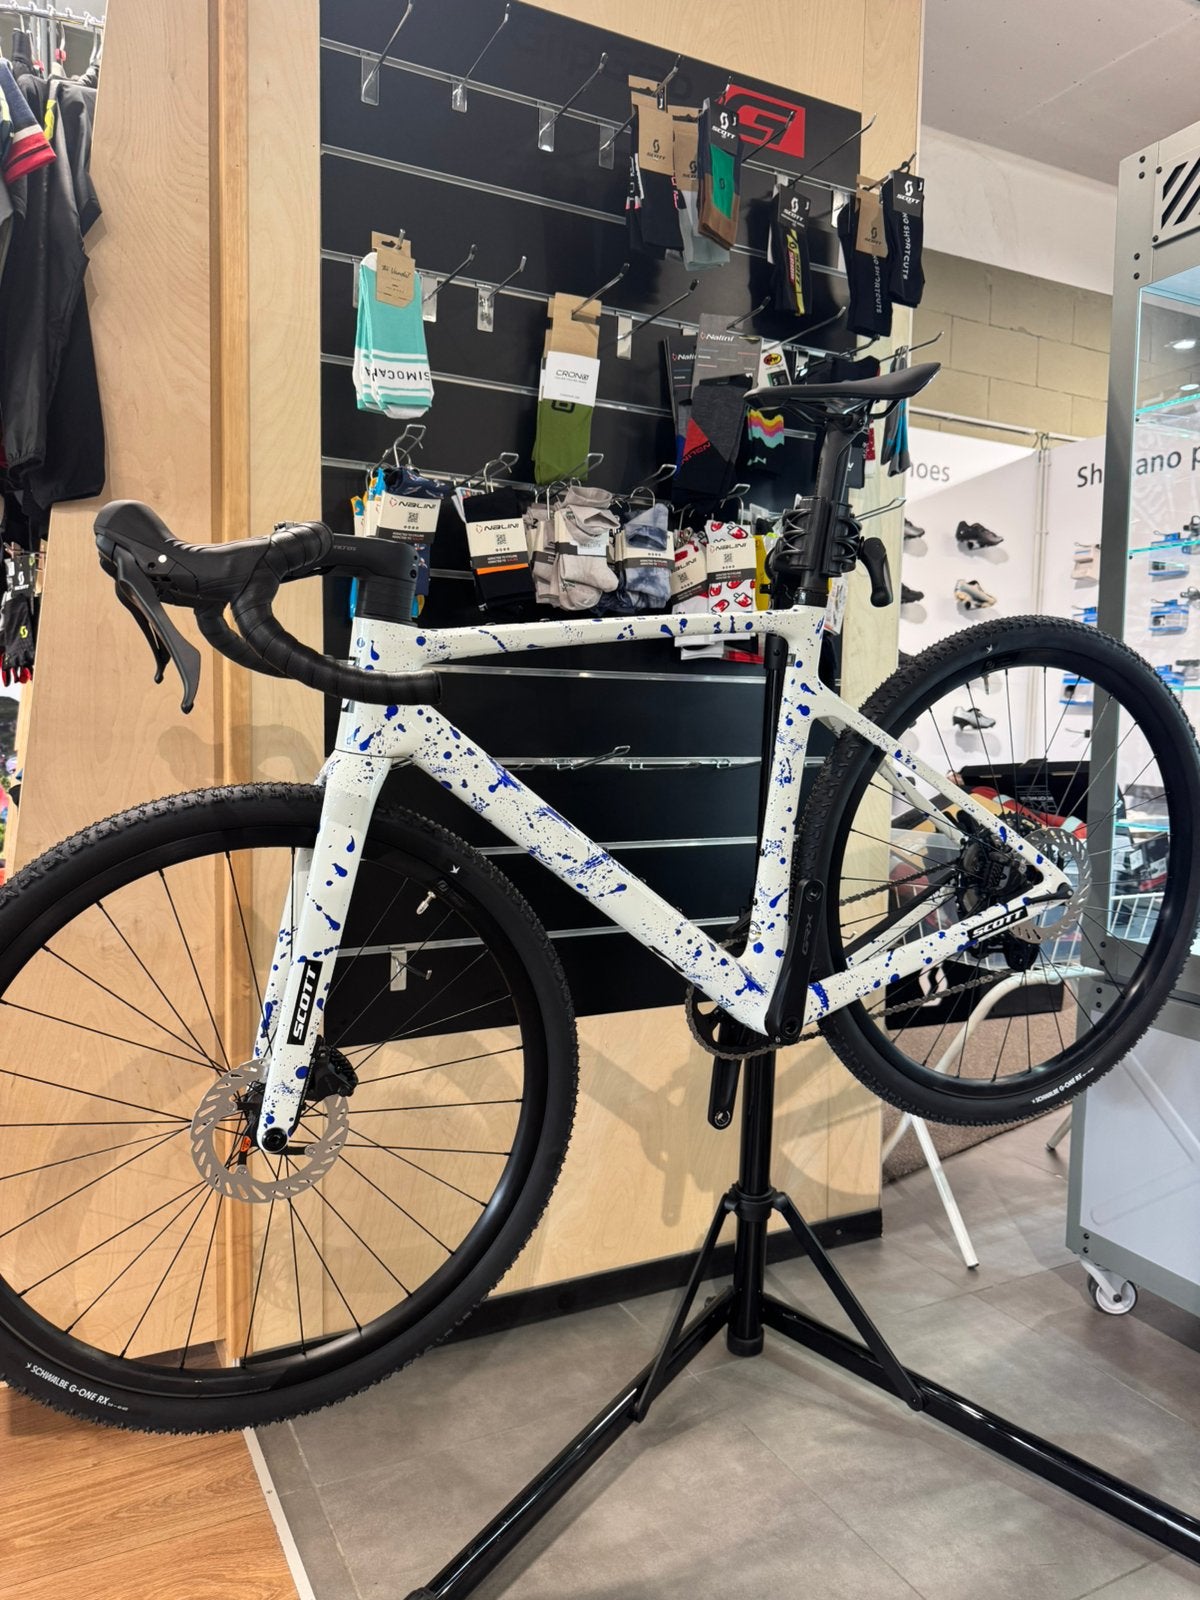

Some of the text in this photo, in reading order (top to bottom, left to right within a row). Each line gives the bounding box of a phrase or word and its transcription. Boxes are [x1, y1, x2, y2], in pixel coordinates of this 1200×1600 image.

[711, 125, 736, 139] SCOTT
[896, 193, 920, 204] SCOTT
[783, 208, 804, 222] SCOTT
[706, 333, 735, 342] Nalini
[972, 909, 1023, 938] SCOTT
[293, 965, 316, 1040] SCOTT
[31, 1365, 110, 1405] SCHWALBE G-ONE RX
